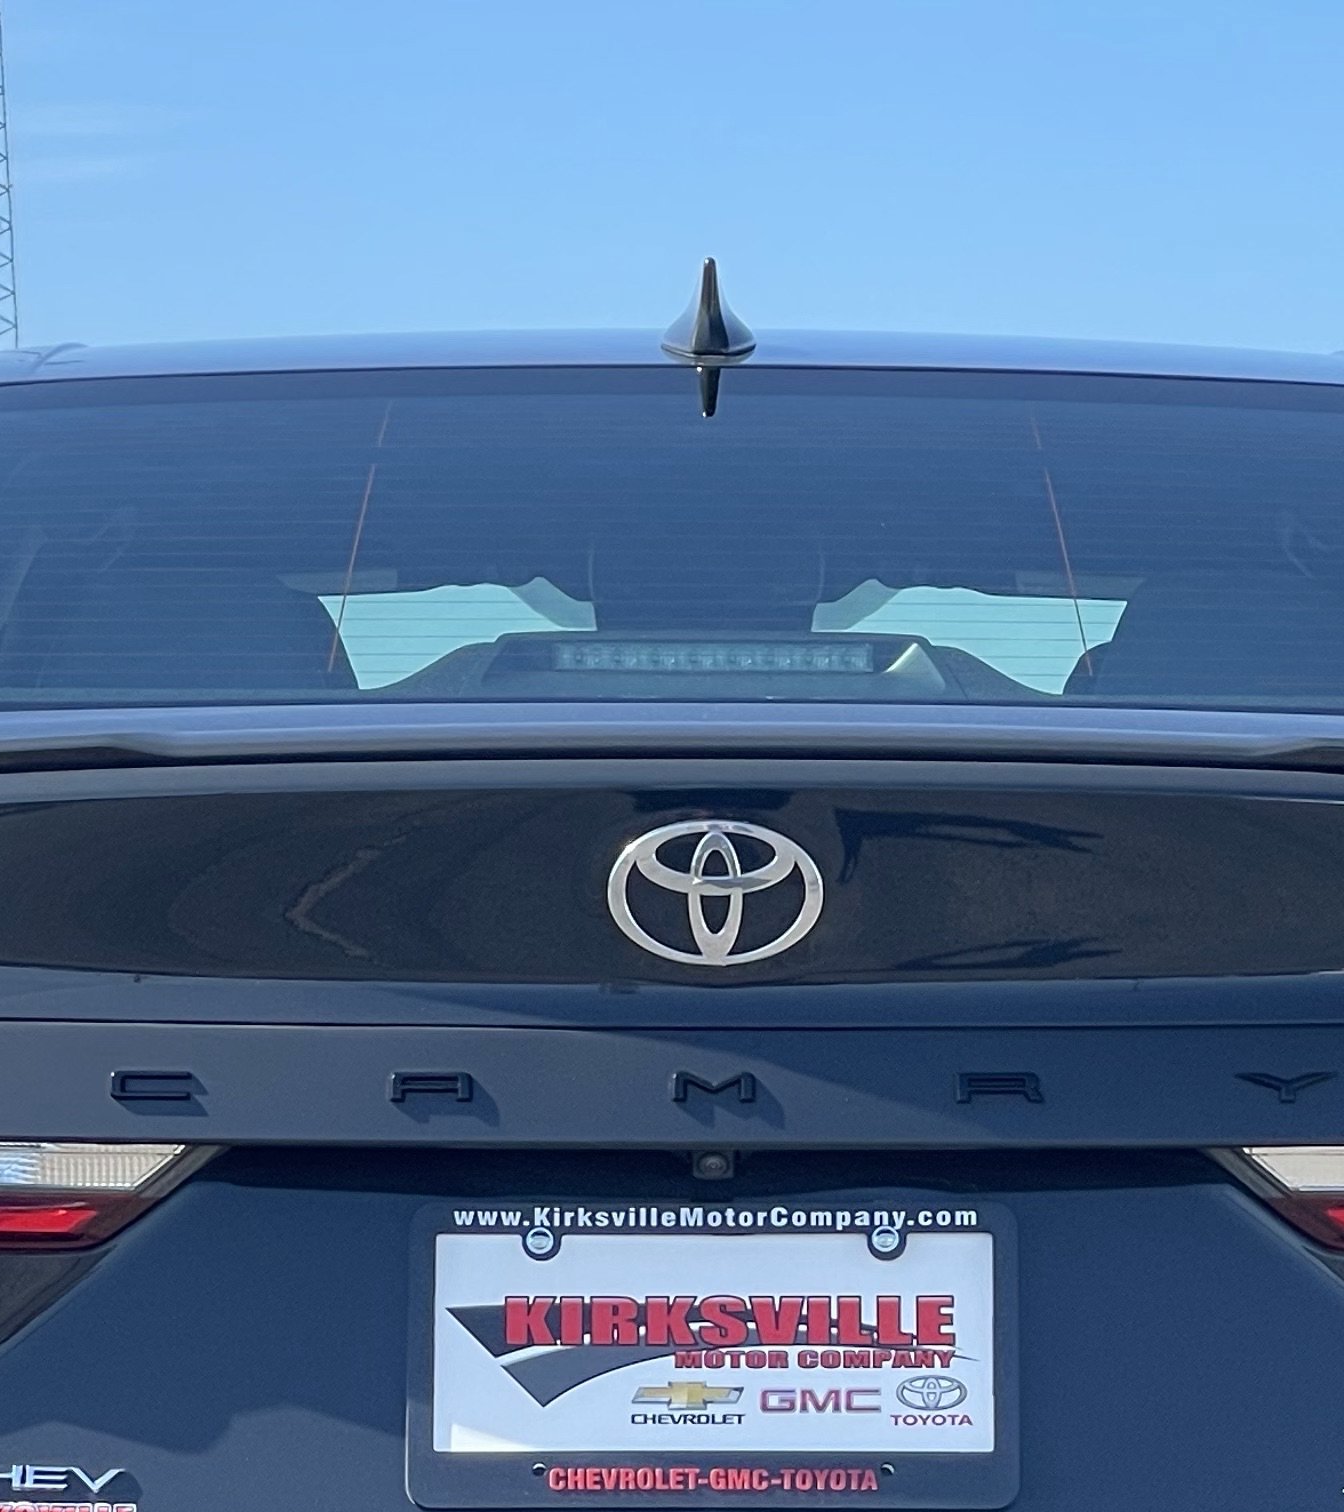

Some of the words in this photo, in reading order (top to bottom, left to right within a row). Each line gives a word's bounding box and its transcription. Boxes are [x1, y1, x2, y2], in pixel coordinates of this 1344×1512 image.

[110, 1070, 1338, 1104] CAMRY
[453, 1206, 978, 1231] www.KirksvilleMotorCompany.com
[504, 1296, 956, 1347] KIRKSVILLE
[673, 1350, 790, 1369] MOTOR
[797, 1350, 955, 1369] COMPANY
[759, 1387, 882, 1414] GMC
[630, 1413, 746, 1426] CHEVROLET
[890, 1414, 974, 1427] TOYOTA
[548, 1467, 879, 1492] CHEVROLET-GMC-TOYOTA
